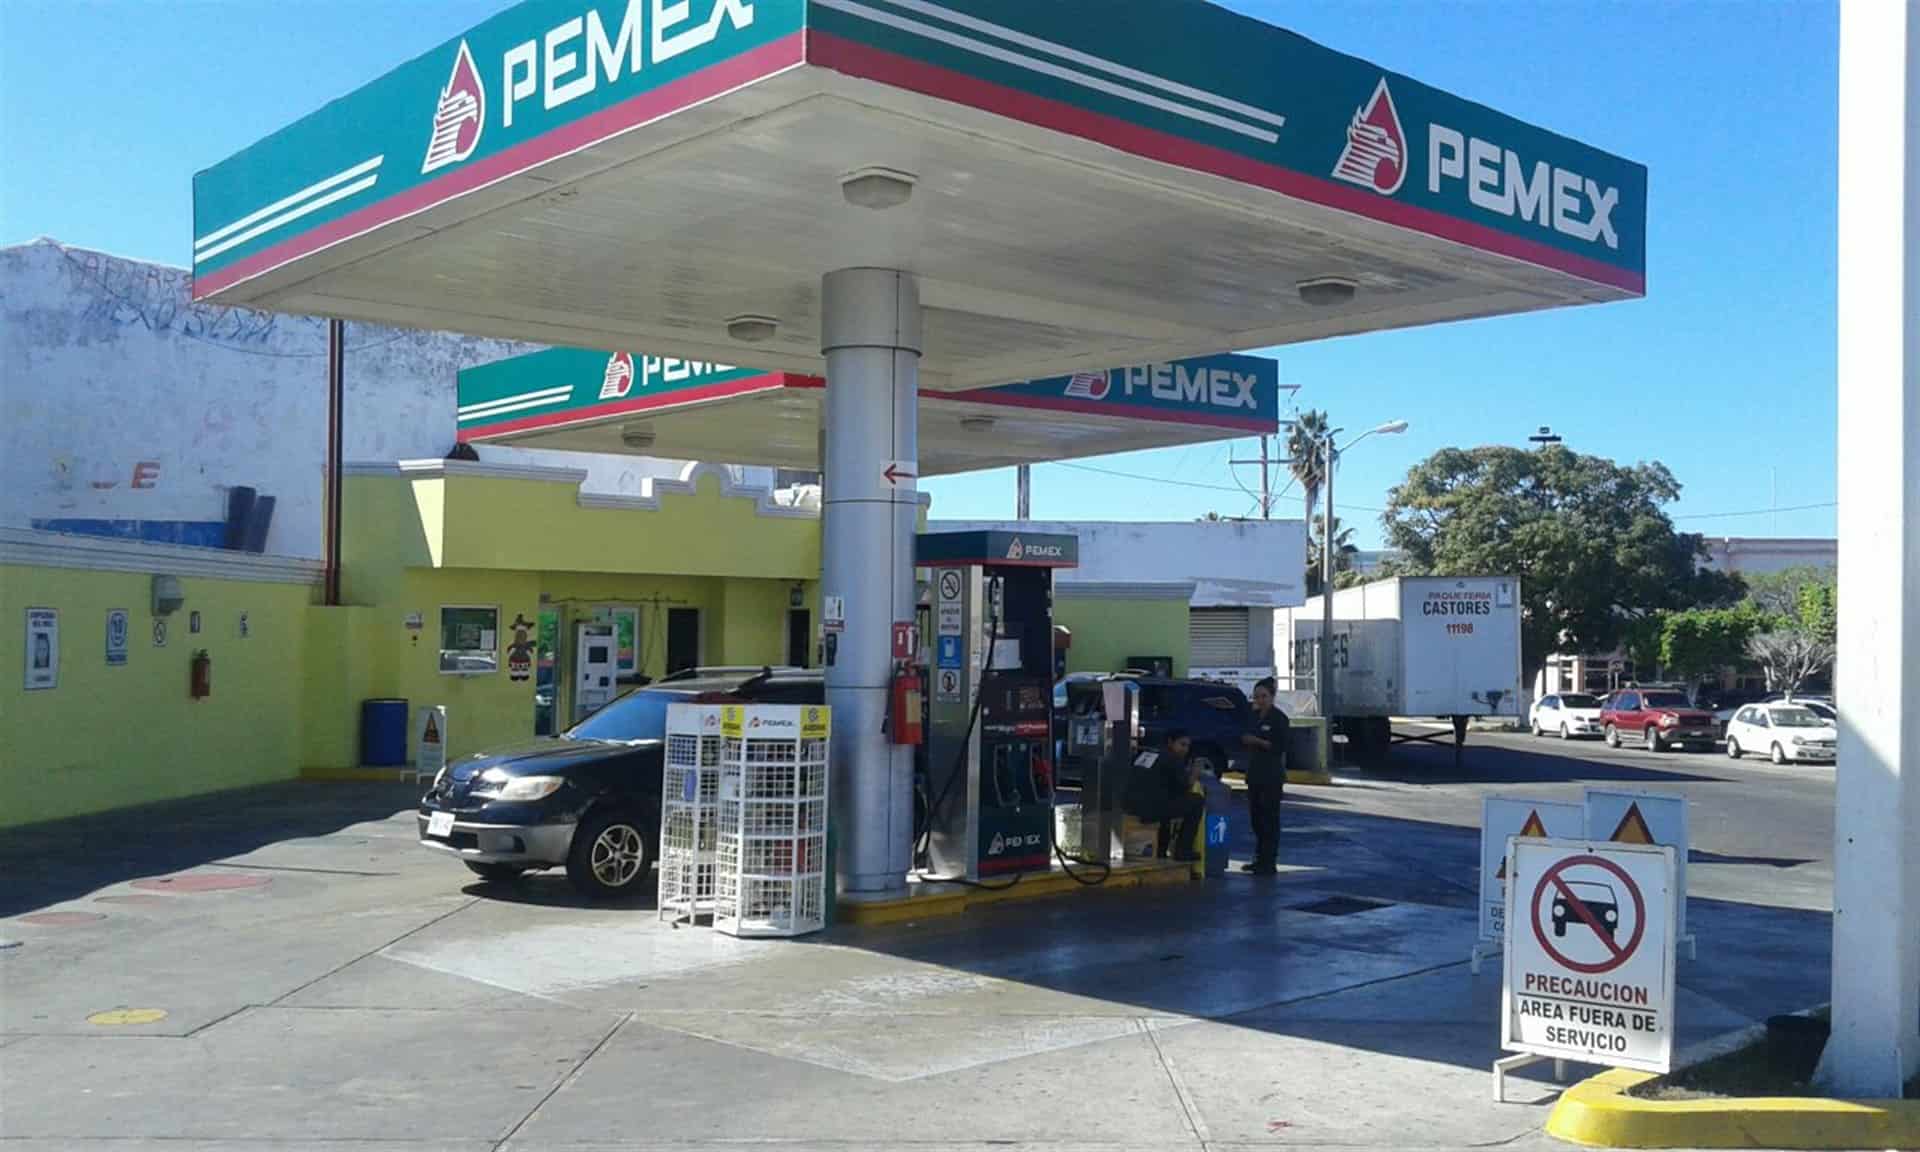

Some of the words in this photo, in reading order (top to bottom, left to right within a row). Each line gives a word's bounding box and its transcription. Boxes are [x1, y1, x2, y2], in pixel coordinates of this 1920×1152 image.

[1428, 122, 1619, 249] PEMEX
[1124, 363, 1257, 408] PEMEX
[1025, 544, 1062, 557] PEMEX
[1423, 601, 1490, 615] CASTORES
[1446, 623, 1473, 634] 11198
[1006, 834, 1041, 848] PEEX
[1525, 973, 1648, 1005] PRECAUCION
[1520, 999, 1564, 1020] AREA
[1569, 1006, 1626, 1030] FUERA
[1632, 1014, 1656, 1033] DE
[1546, 1026, 1627, 1052] SERVICIO
